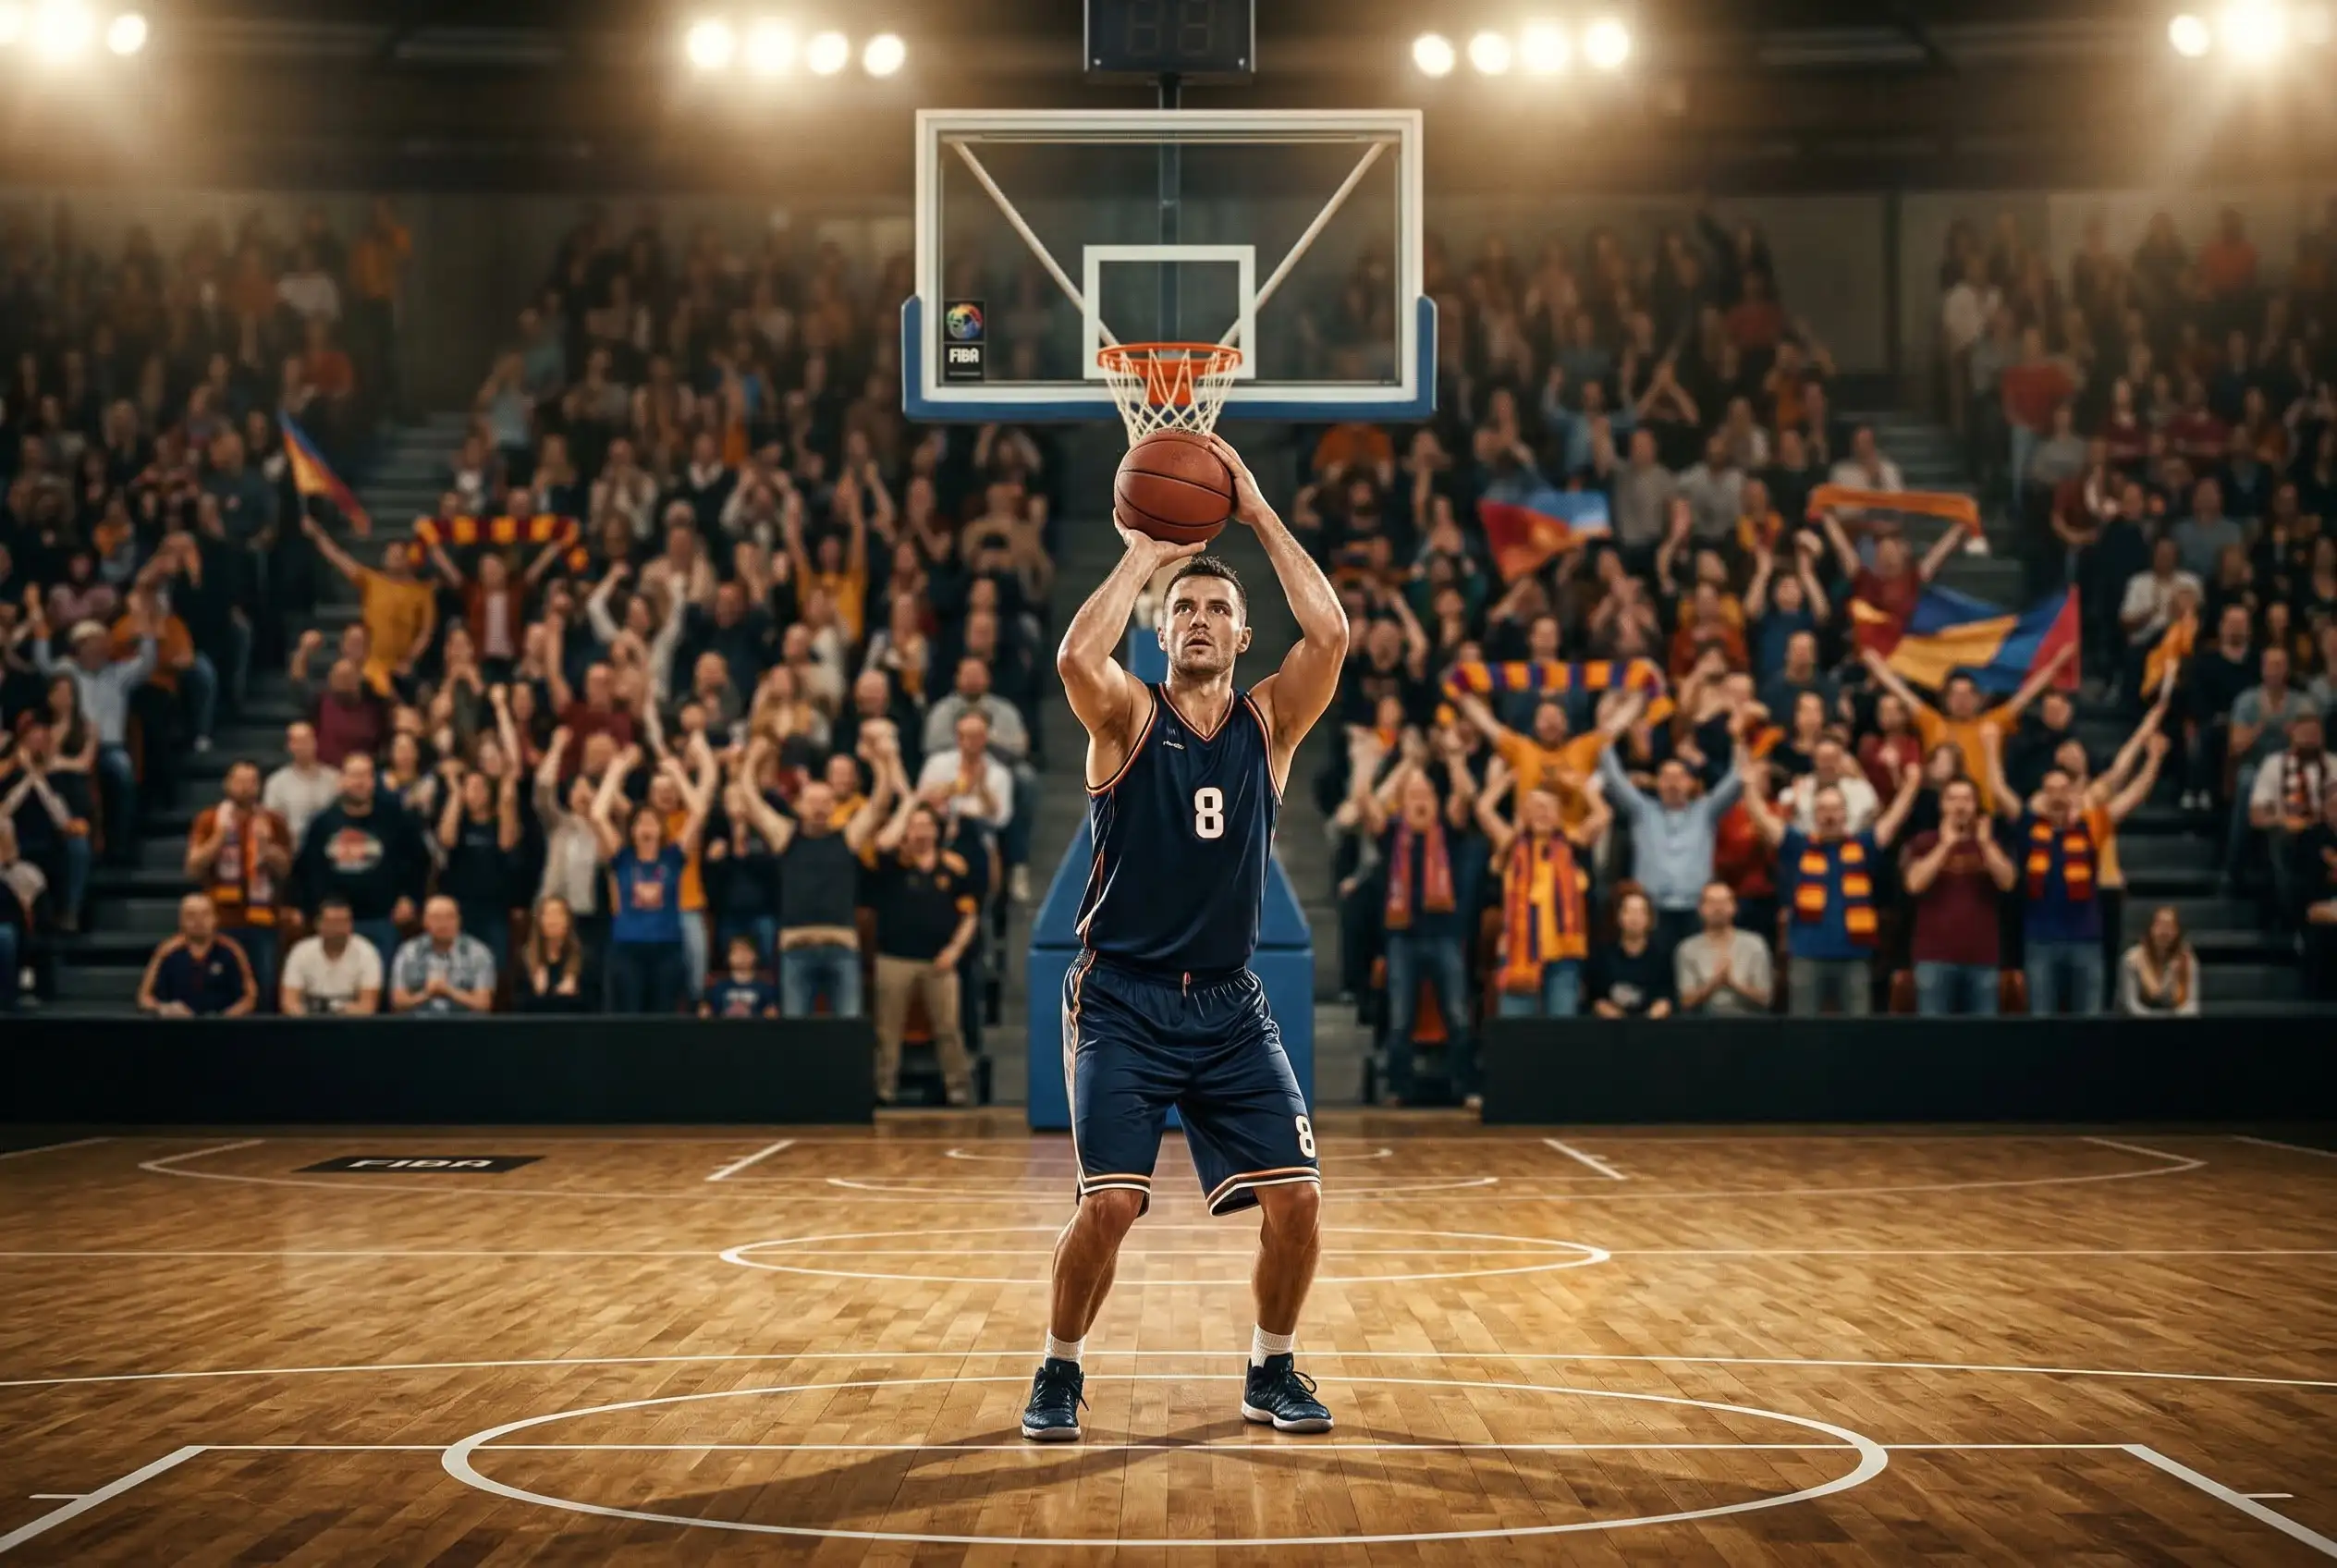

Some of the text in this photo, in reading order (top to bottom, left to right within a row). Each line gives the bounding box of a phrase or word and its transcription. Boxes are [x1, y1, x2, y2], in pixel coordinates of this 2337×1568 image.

[948, 347, 980, 363] FIBA
[1193, 787, 1224, 839] 8
[1295, 1115, 1315, 1158] 8
[346, 1158, 496, 1169] FIBA
